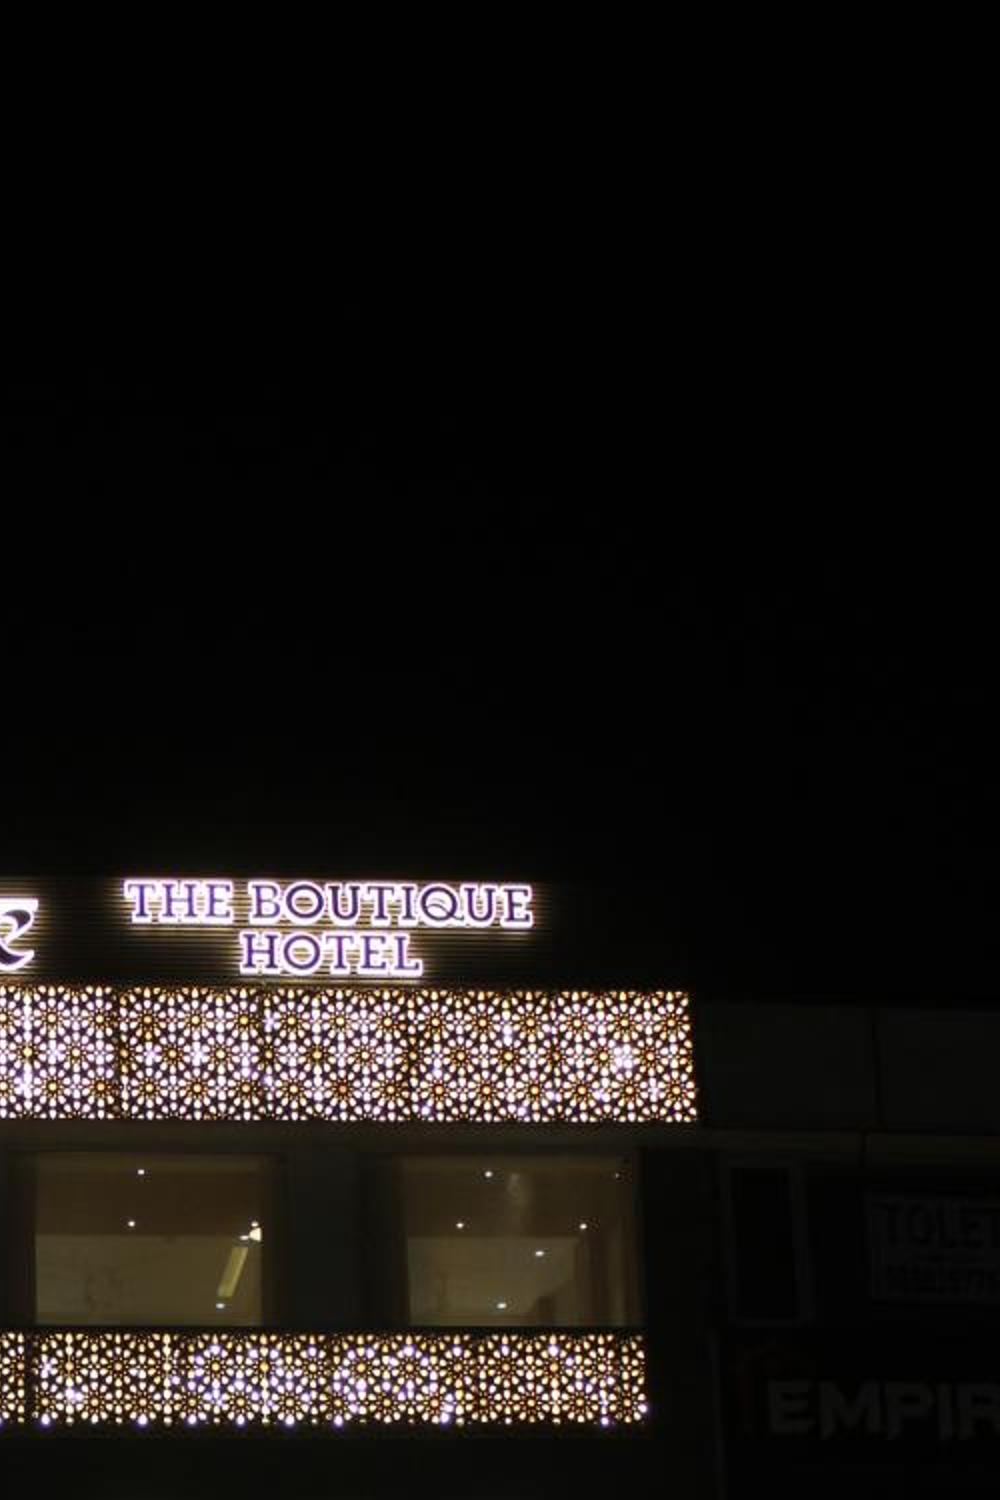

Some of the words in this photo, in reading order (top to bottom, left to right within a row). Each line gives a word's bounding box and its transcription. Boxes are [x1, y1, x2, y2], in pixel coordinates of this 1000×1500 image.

[126, 882, 232, 920] THE
[250, 884, 532, 925] BOUTIQUE
[242, 932, 422, 974] HOTEL
